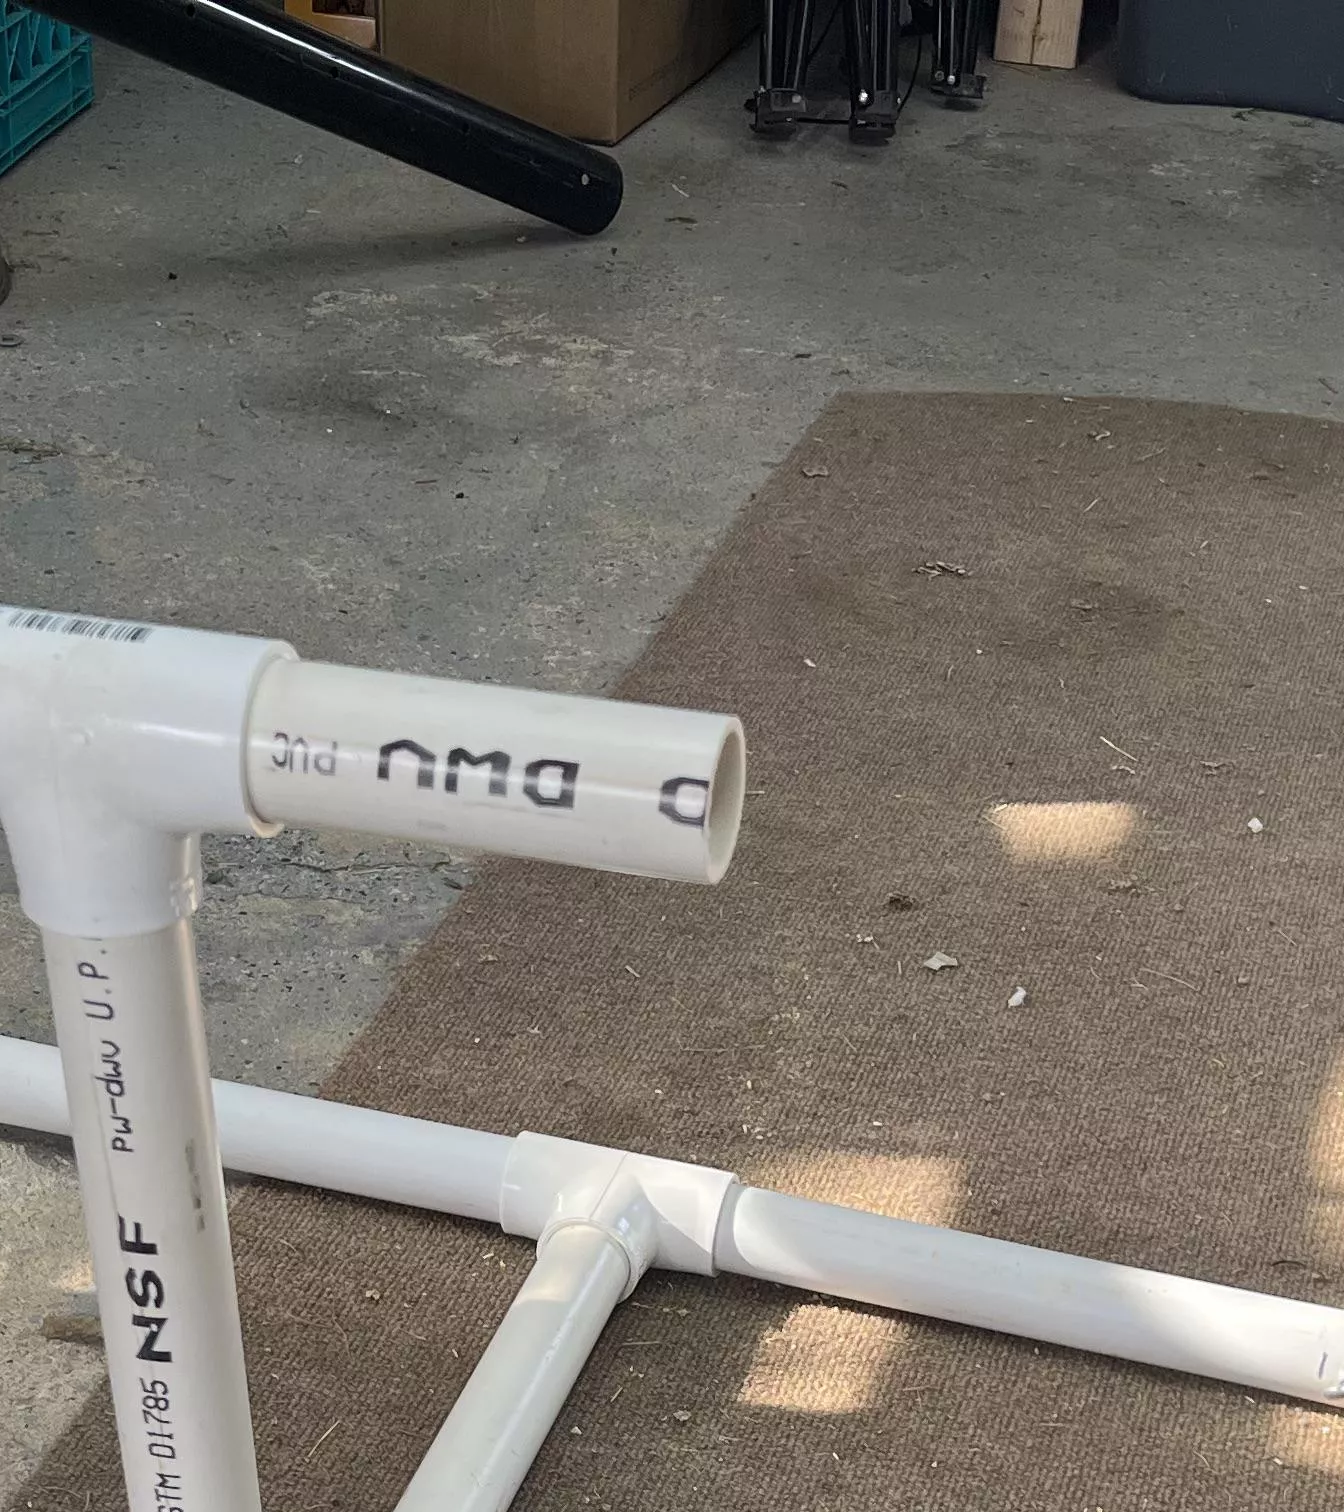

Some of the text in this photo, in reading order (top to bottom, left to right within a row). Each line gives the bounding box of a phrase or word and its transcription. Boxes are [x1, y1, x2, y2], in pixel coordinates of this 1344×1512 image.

[77, 937, 115, 1021] U.P.
[118, 1212, 173, 1363] NSF
[139, 1377, 177, 1460] D1785
